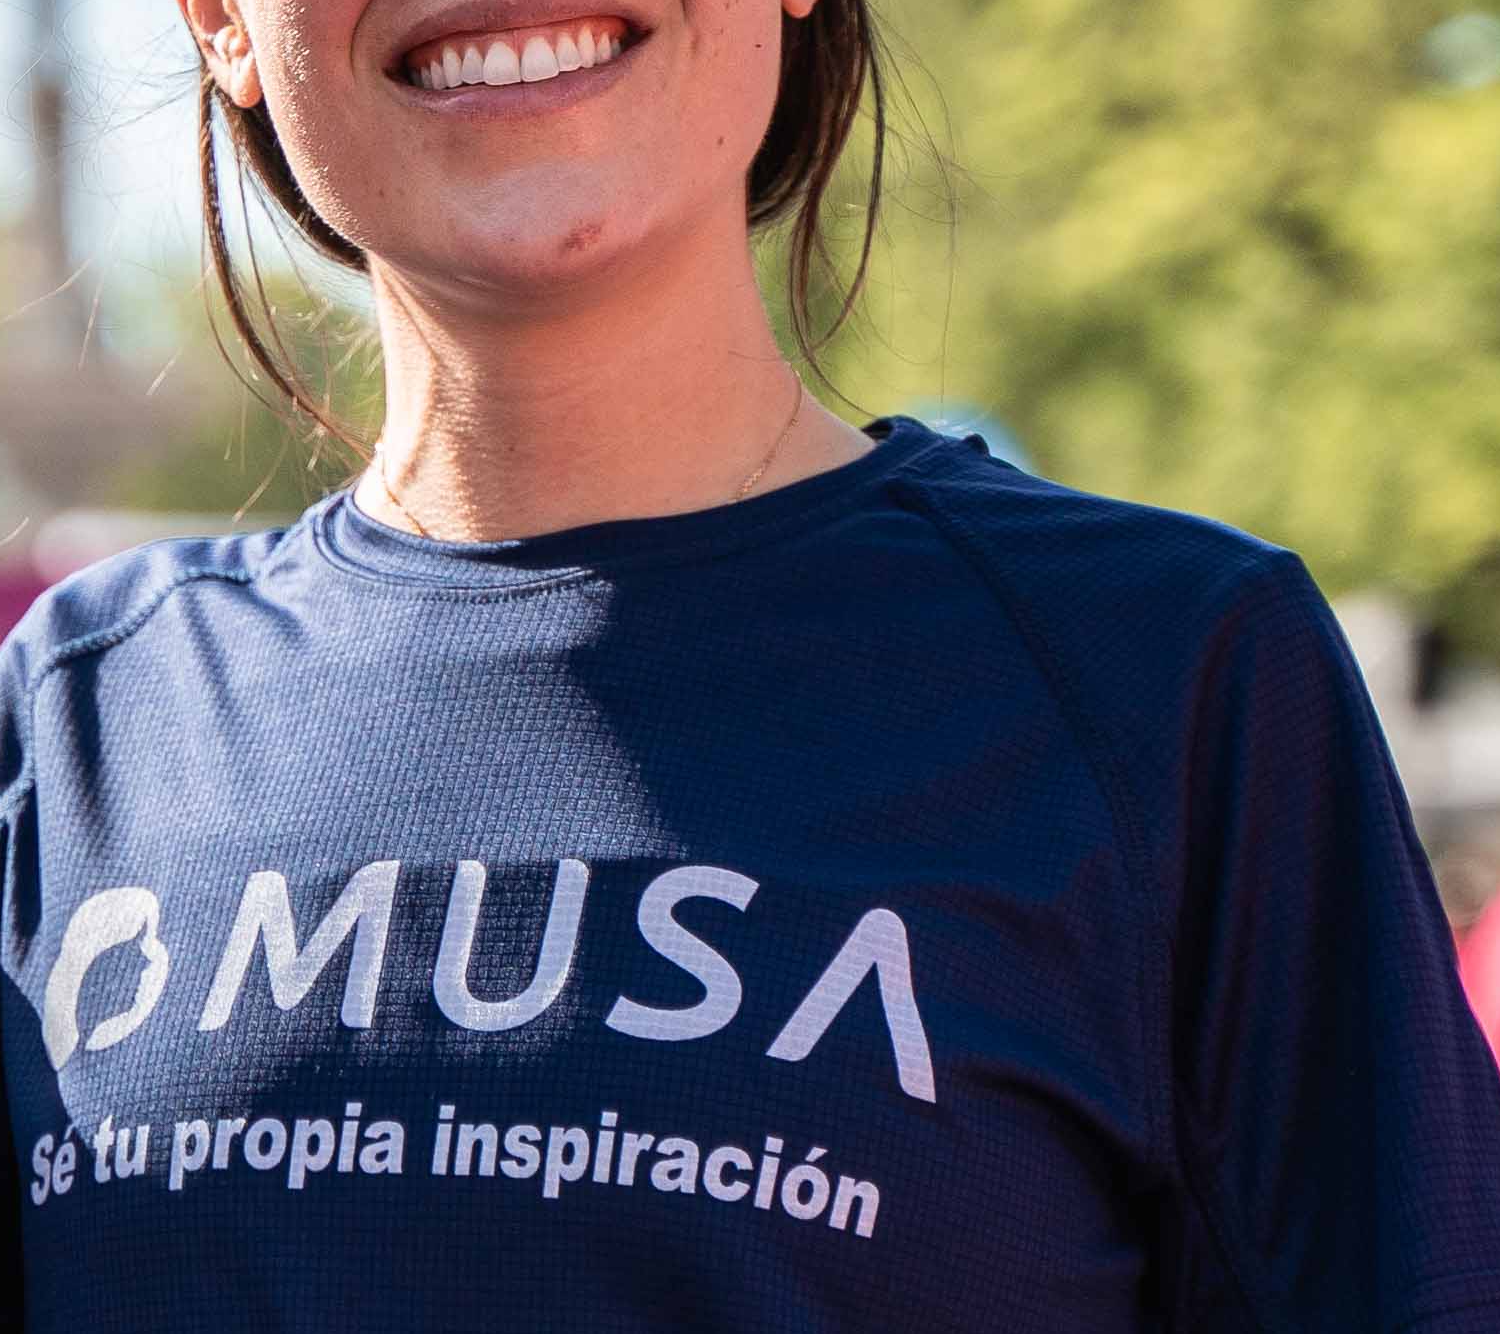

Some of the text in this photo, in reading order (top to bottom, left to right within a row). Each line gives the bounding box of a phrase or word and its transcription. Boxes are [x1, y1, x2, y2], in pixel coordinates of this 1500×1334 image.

[197, 857, 937, 1105] MUSA
[30, 1101, 881, 1240] Sé tu propia inspiración
